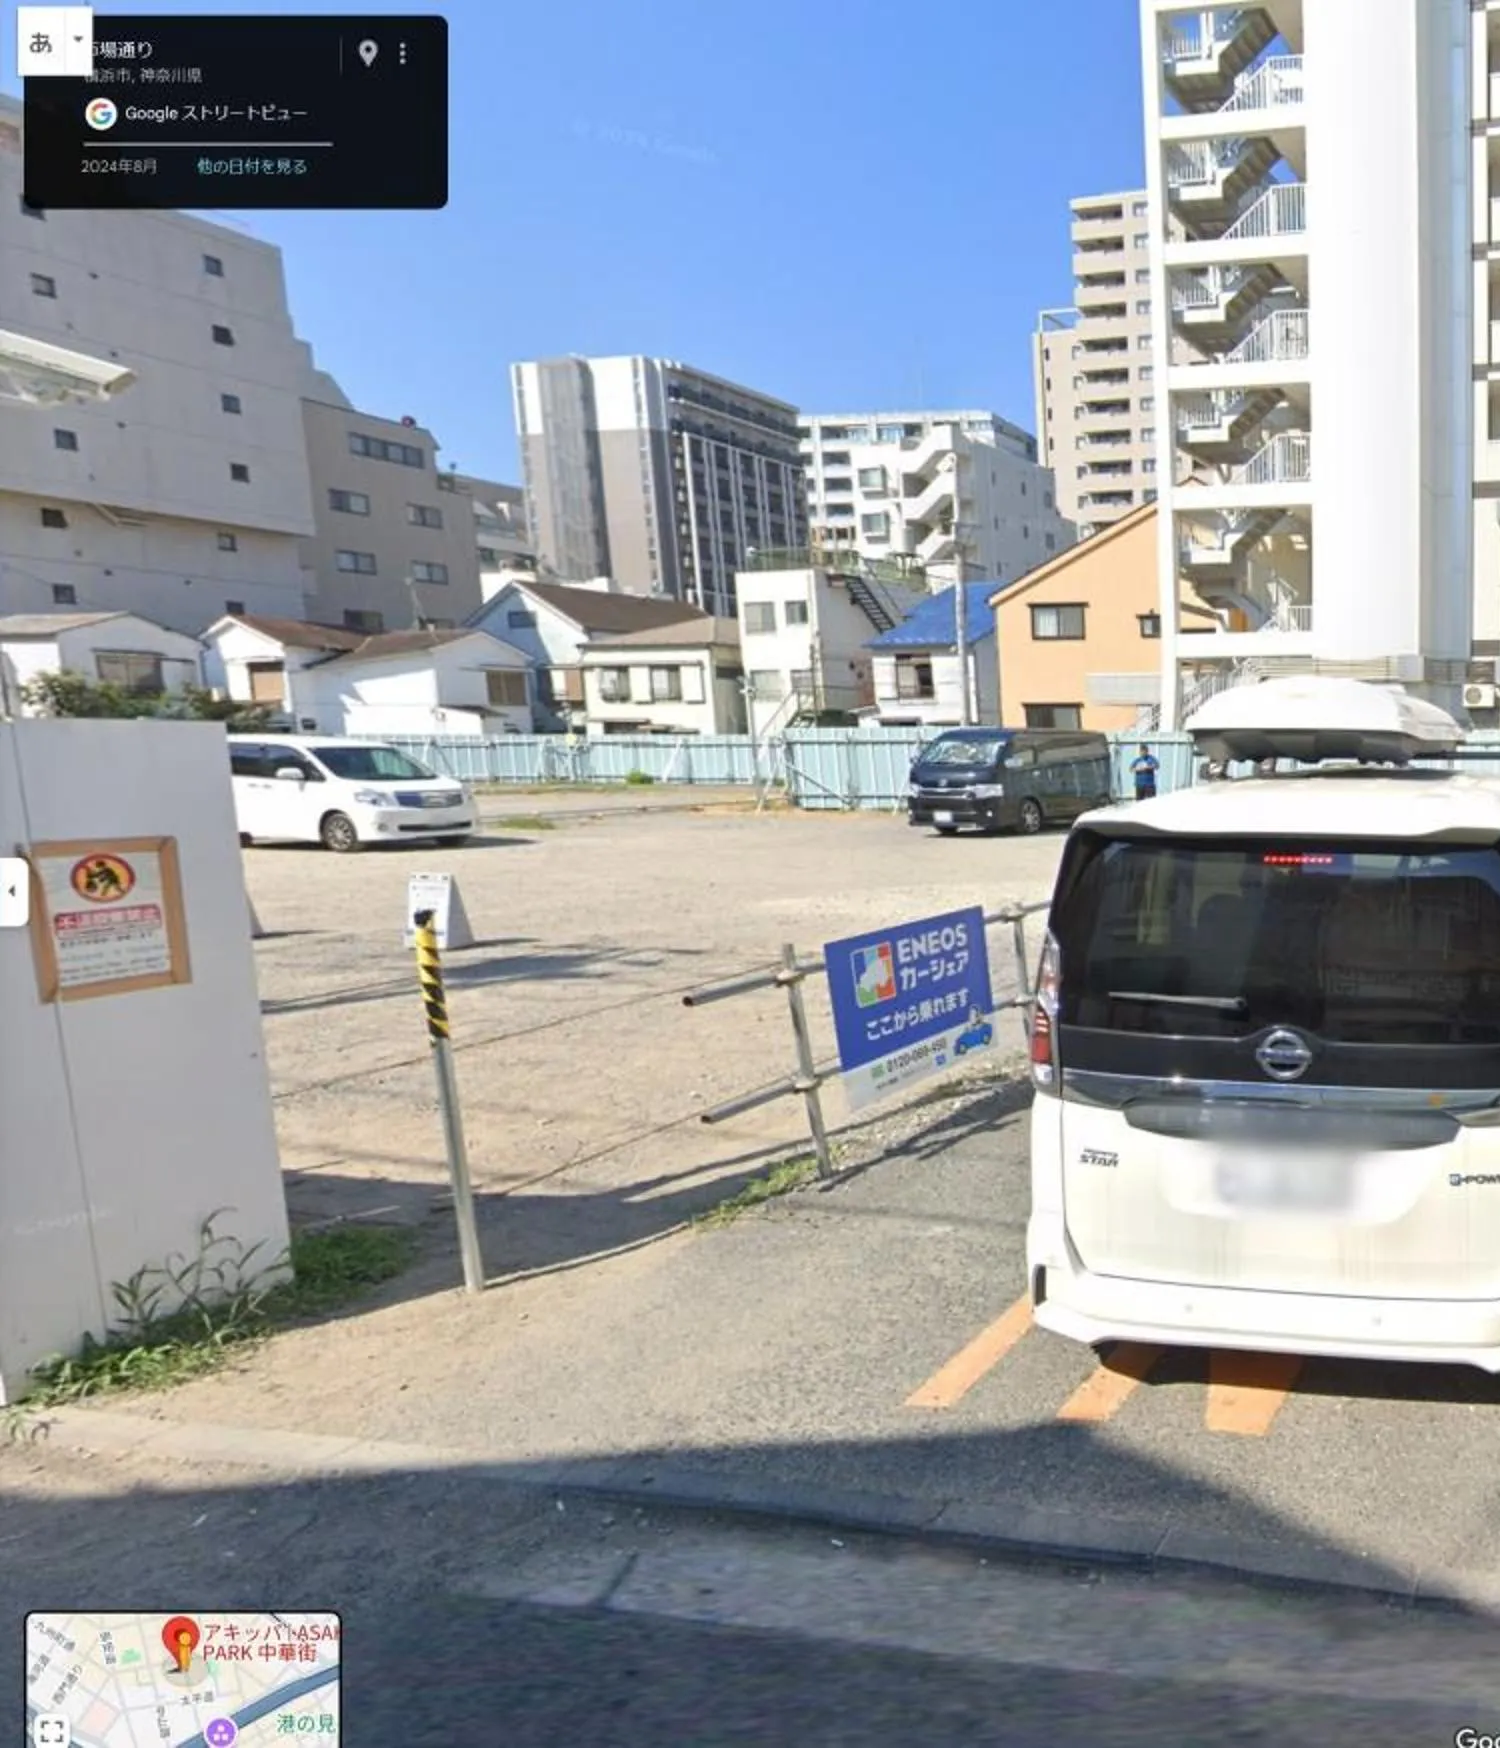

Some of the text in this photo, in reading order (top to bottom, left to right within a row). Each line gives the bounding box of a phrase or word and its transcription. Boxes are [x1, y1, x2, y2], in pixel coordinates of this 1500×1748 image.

[896, 923, 969, 963] ENEOS
[900, 951, 970, 991] カーシェア
[866, 987, 970, 1041] ここから乗れます
